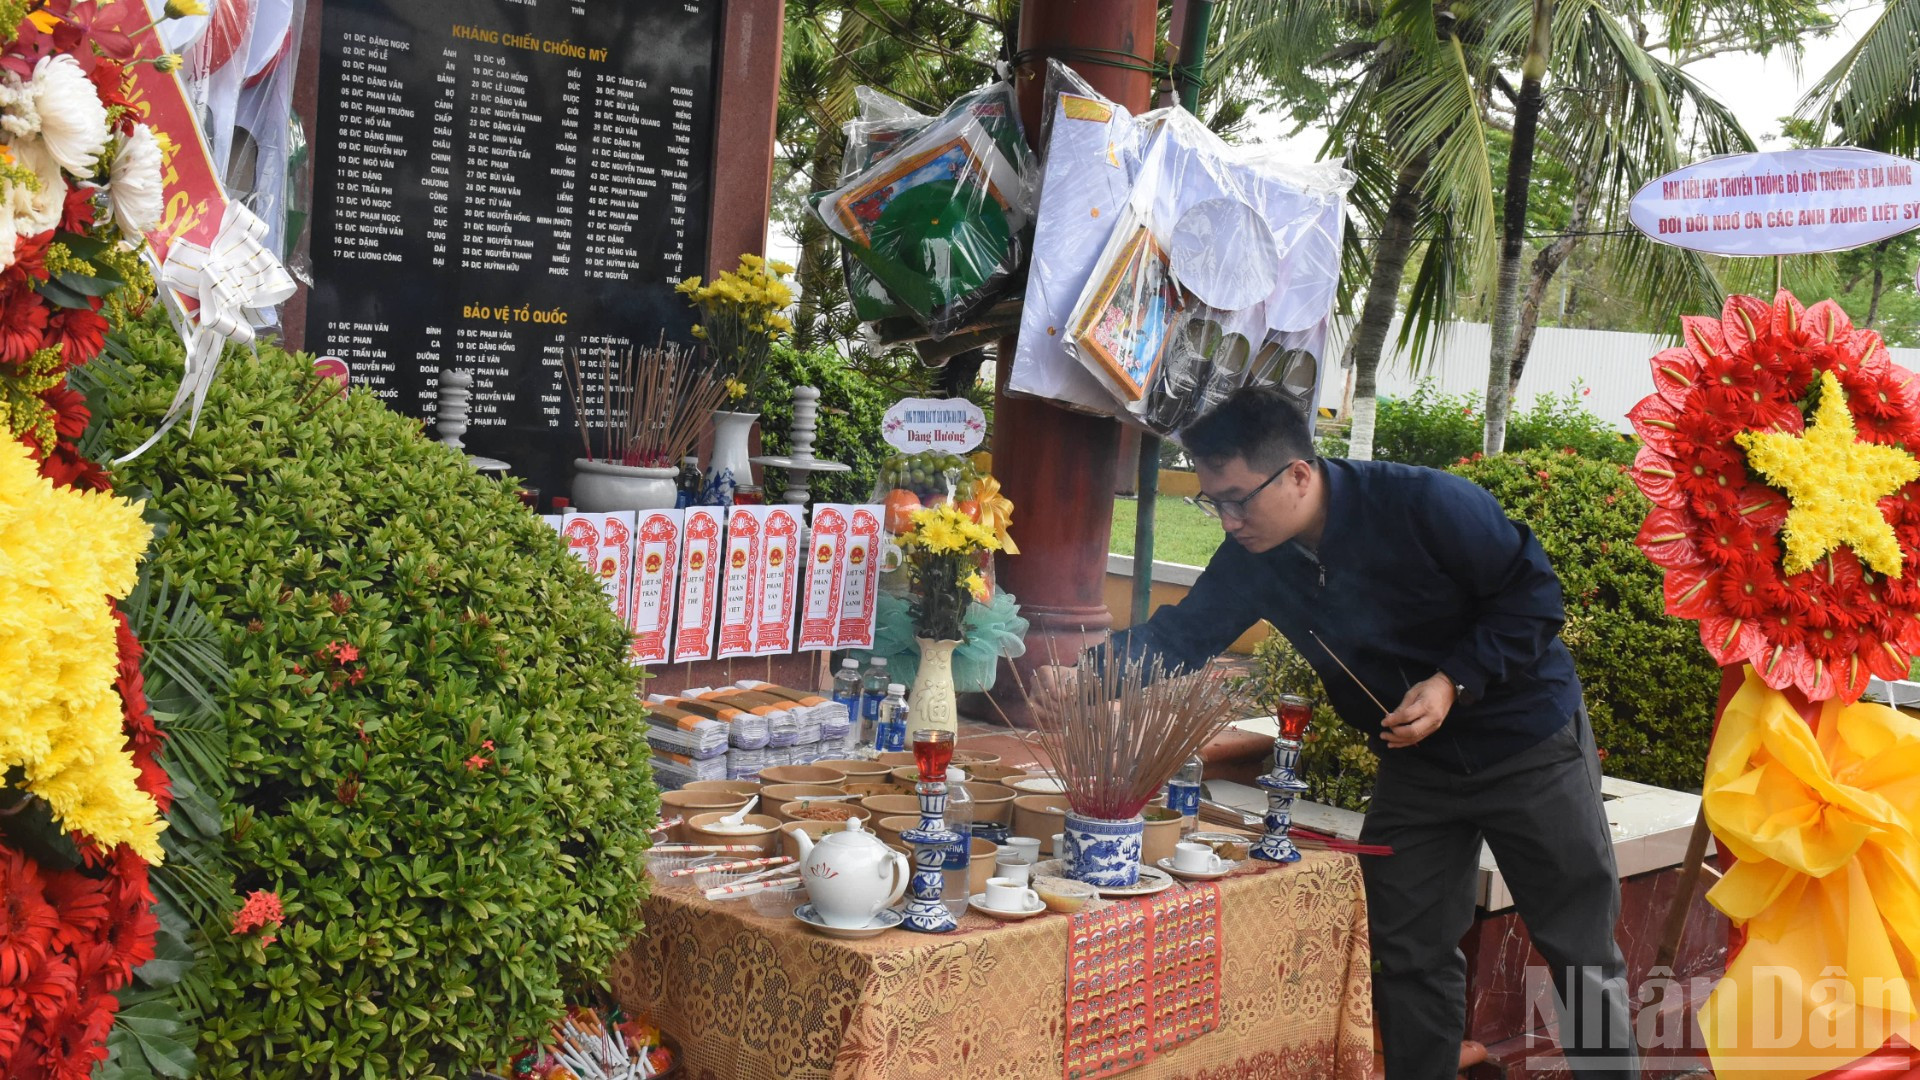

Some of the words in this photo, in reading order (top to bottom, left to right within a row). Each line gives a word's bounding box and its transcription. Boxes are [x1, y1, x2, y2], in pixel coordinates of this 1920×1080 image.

[344, 33, 351, 41] 01
[354, 34, 365, 42] Đ/C
[391, 41, 410, 51] NGỌC
[452, 24, 498, 44] KHÁNG
[502, 33, 539, 51] CHIẾN
[543, 39, 586, 59] CHỐNG
[589, 48, 608, 62] MỸ
[354, 48, 365, 56] Đ/C
[342, 60, 350, 68] 03
[353, 61, 364, 69] Đ/C
[368, 64, 386, 74] PHAN
[352, 88, 363, 96] Đ/C
[366, 90, 385, 100] PHAN
[351, 102, 362, 110] Đ/C
[366, 104, 385, 115] PHẠM
[673, 99, 692, 108] QUANG
[338, 142, 346, 150] 09
[349, 143, 360, 151] Đ/C
[364, 144, 392, 155] NGUYỄN
[431, 153, 451, 162] CHINH
[348, 156, 360, 164] Đ/C
[491, 161, 508, 170] PHẠM
[1663, 181, 1680, 200] BAN
[1683, 176, 1699, 199] LIÊN
[1703, 178, 1718, 201] LẠC
[1720, 170, 1752, 197] TRUYỀN
[1755, 169, 1783, 195] THỐNG
[1787, 170, 1799, 196] BỘ
[1801, 170, 1817, 195] ĐỘI
[1819, 167, 1855, 191] TRƯỜNG
[1858, 169, 1869, 189] SA
[1872, 164, 1884, 187] ĐÀ
[465, 196, 472, 204] 29
[557, 206, 572, 214] LONG
[610, 211, 625, 220] PHAN
[1659, 215, 1681, 234] ĐỜI
[1686, 213, 1708, 232] ĐỜI
[1713, 212, 1740, 230] NHỚ
[1745, 211, 1762, 229] ƠN
[1766, 209, 1793, 228] CÁC
[1799, 209, 1825, 225] ANH
[1830, 206, 1867, 223] HÙNG
[1872, 203, 1898, 223] LIỆT
[464, 302, 490, 319] BẢO
[494, 306, 509, 324] VỆ
[514, 303, 529, 322] TỔ
[533, 307, 568, 324] QUỐC
[339, 322, 350, 330] Đ/C
[354, 324, 372, 332] PHAN
[374, 323, 388, 332] VĂN
[353, 336, 372, 344] PHAN
[908, 430, 931, 445] Dâng
[934, 430, 965, 444] Hương
[917, 680, 950, 723] 福
